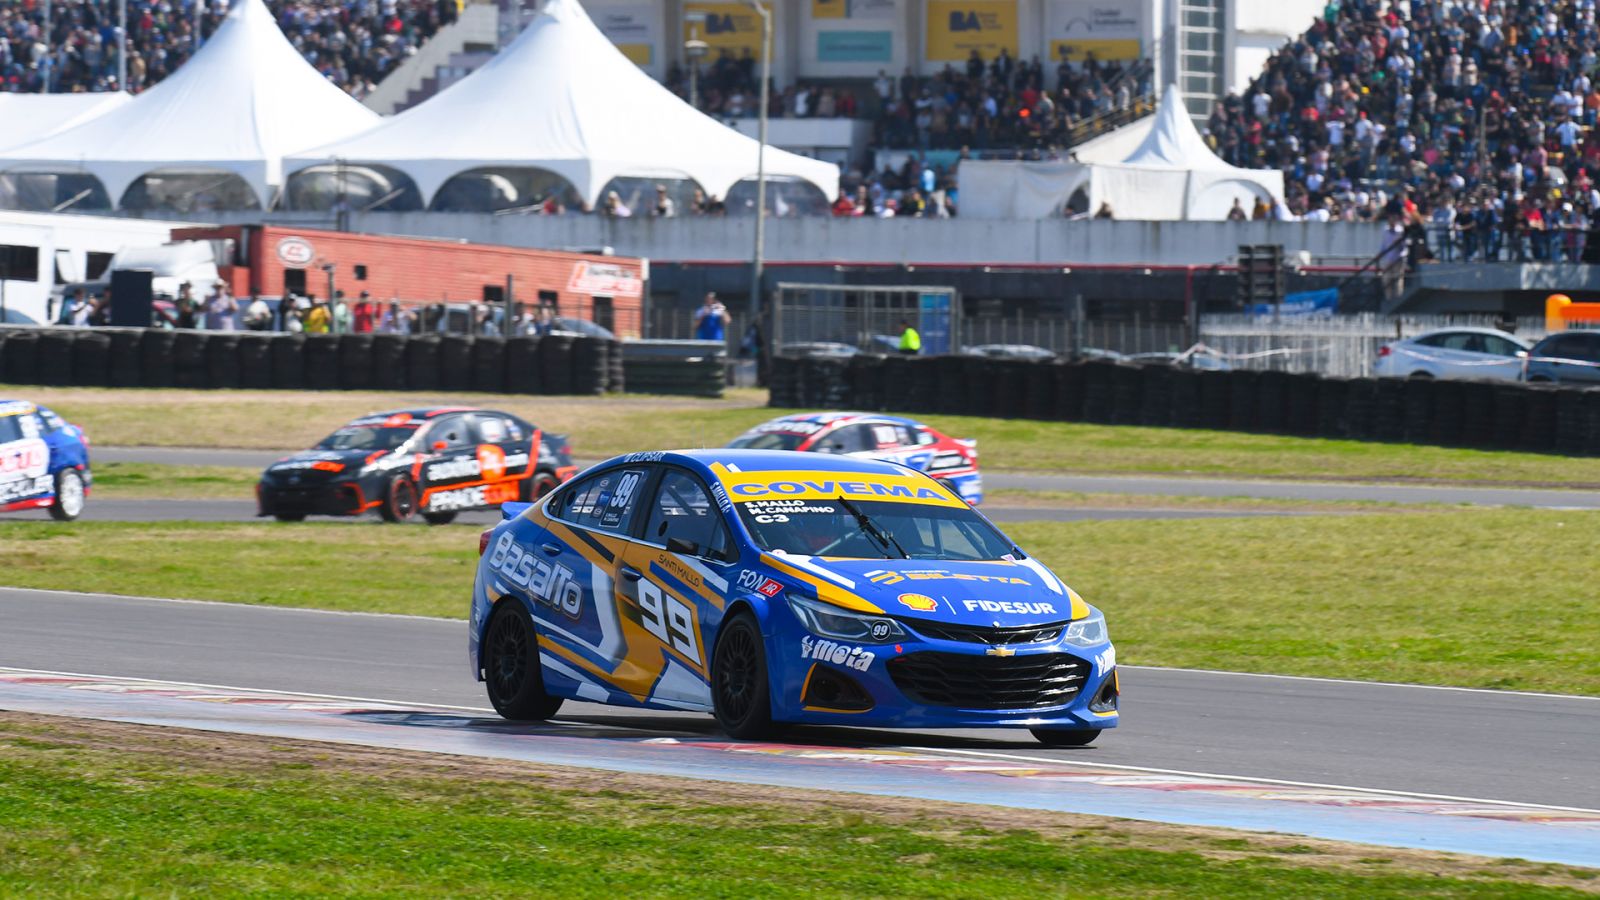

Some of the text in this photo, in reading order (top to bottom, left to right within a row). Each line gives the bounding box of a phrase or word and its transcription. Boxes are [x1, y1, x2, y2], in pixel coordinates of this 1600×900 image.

[610, 473, 639, 507] 99
[732, 480, 948, 500] COVEMA
[755, 515, 790, 524] C3
[962, 599, 1057, 615] FIDESUR
[638, 577, 702, 666] 99
[873, 624, 888, 636] 99
